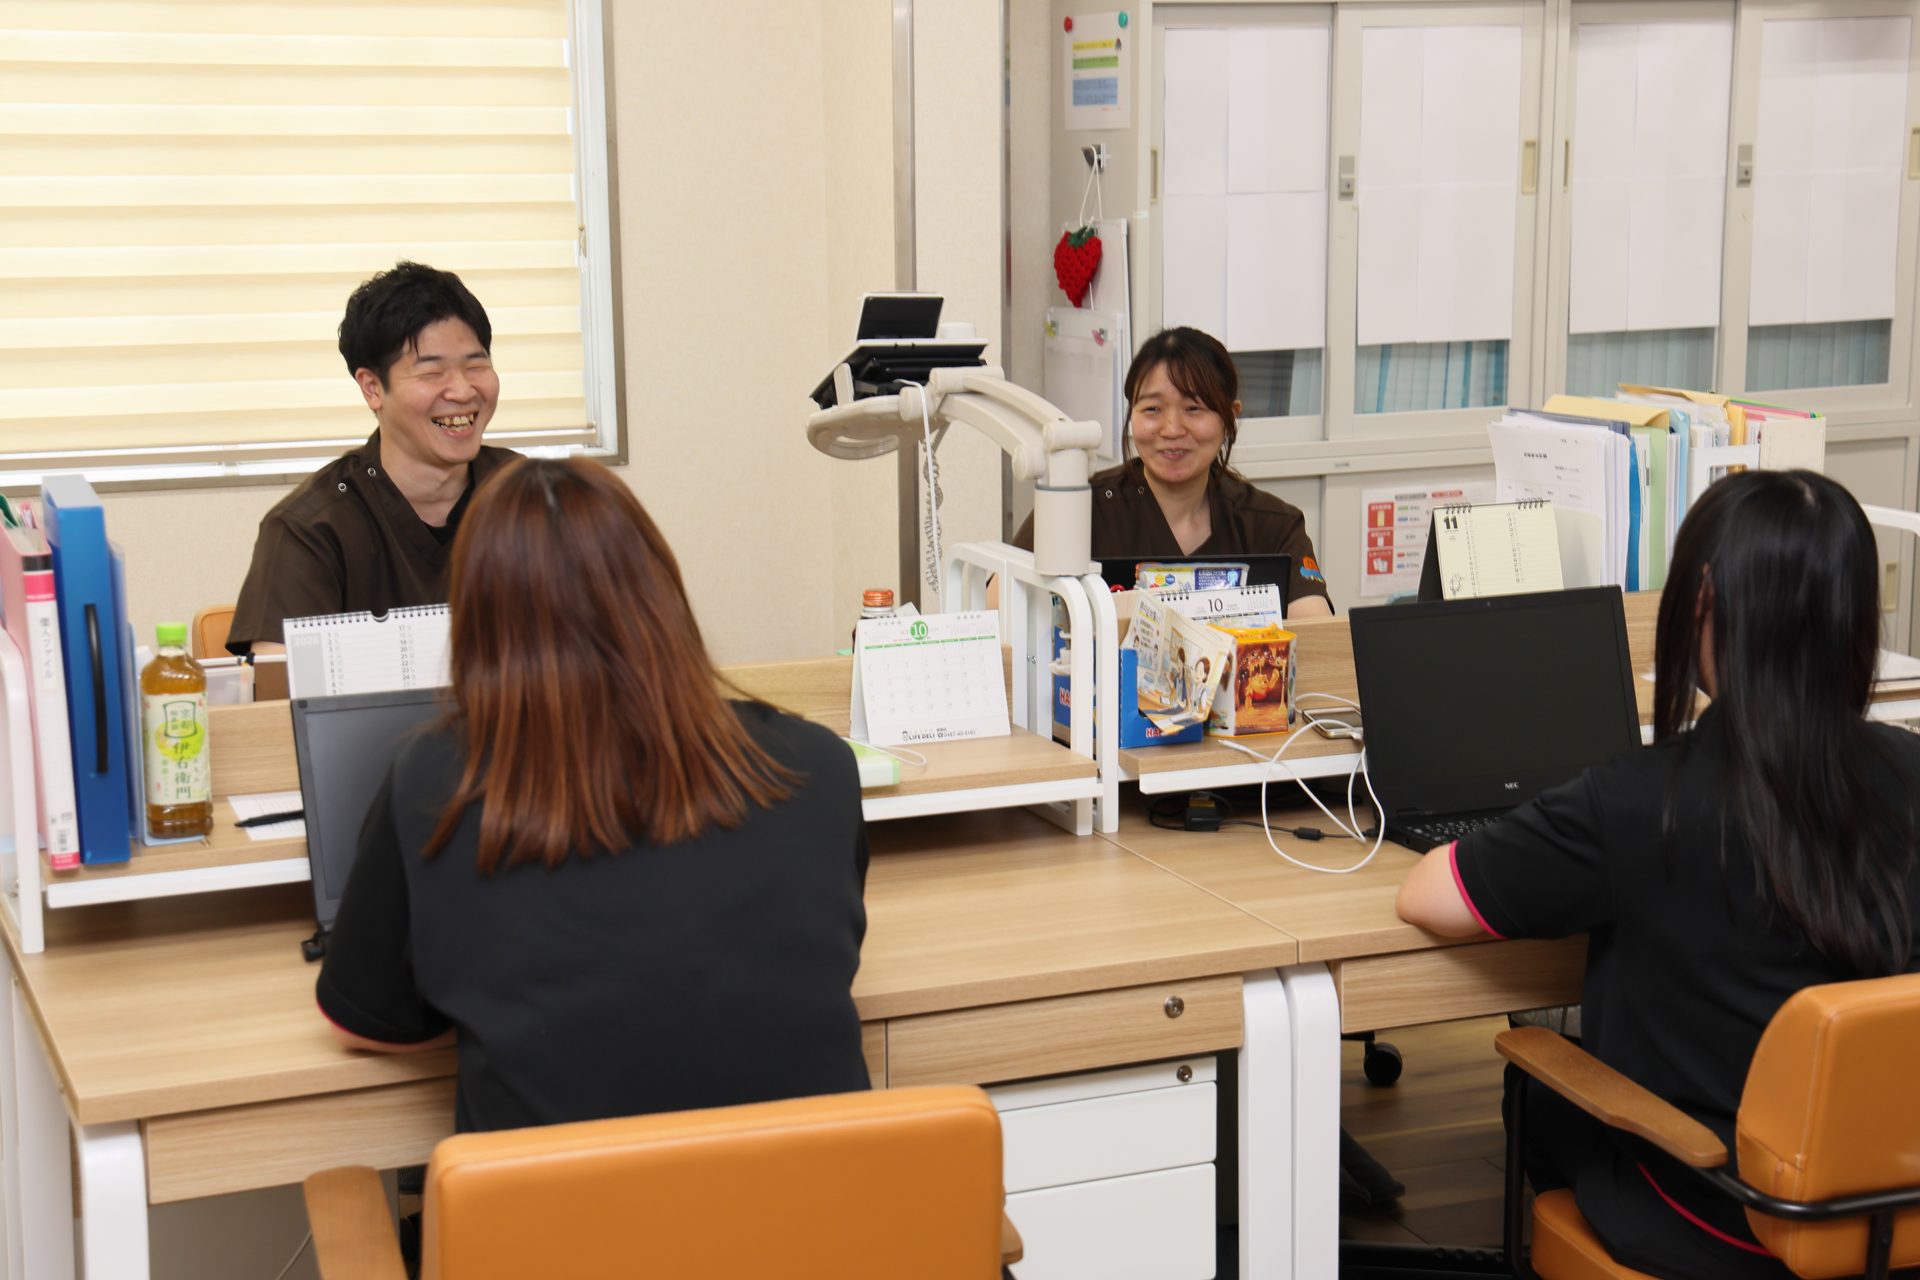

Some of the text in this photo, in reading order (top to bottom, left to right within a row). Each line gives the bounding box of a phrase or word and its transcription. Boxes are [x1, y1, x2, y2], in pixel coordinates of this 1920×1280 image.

[1444, 516, 1458, 529] 11
[1208, 598, 1223, 612] 10
[911, 623, 927, 638] 10
[173, 742, 192, 800] 伊右衛門
[1504, 782, 1520, 790] NEC
